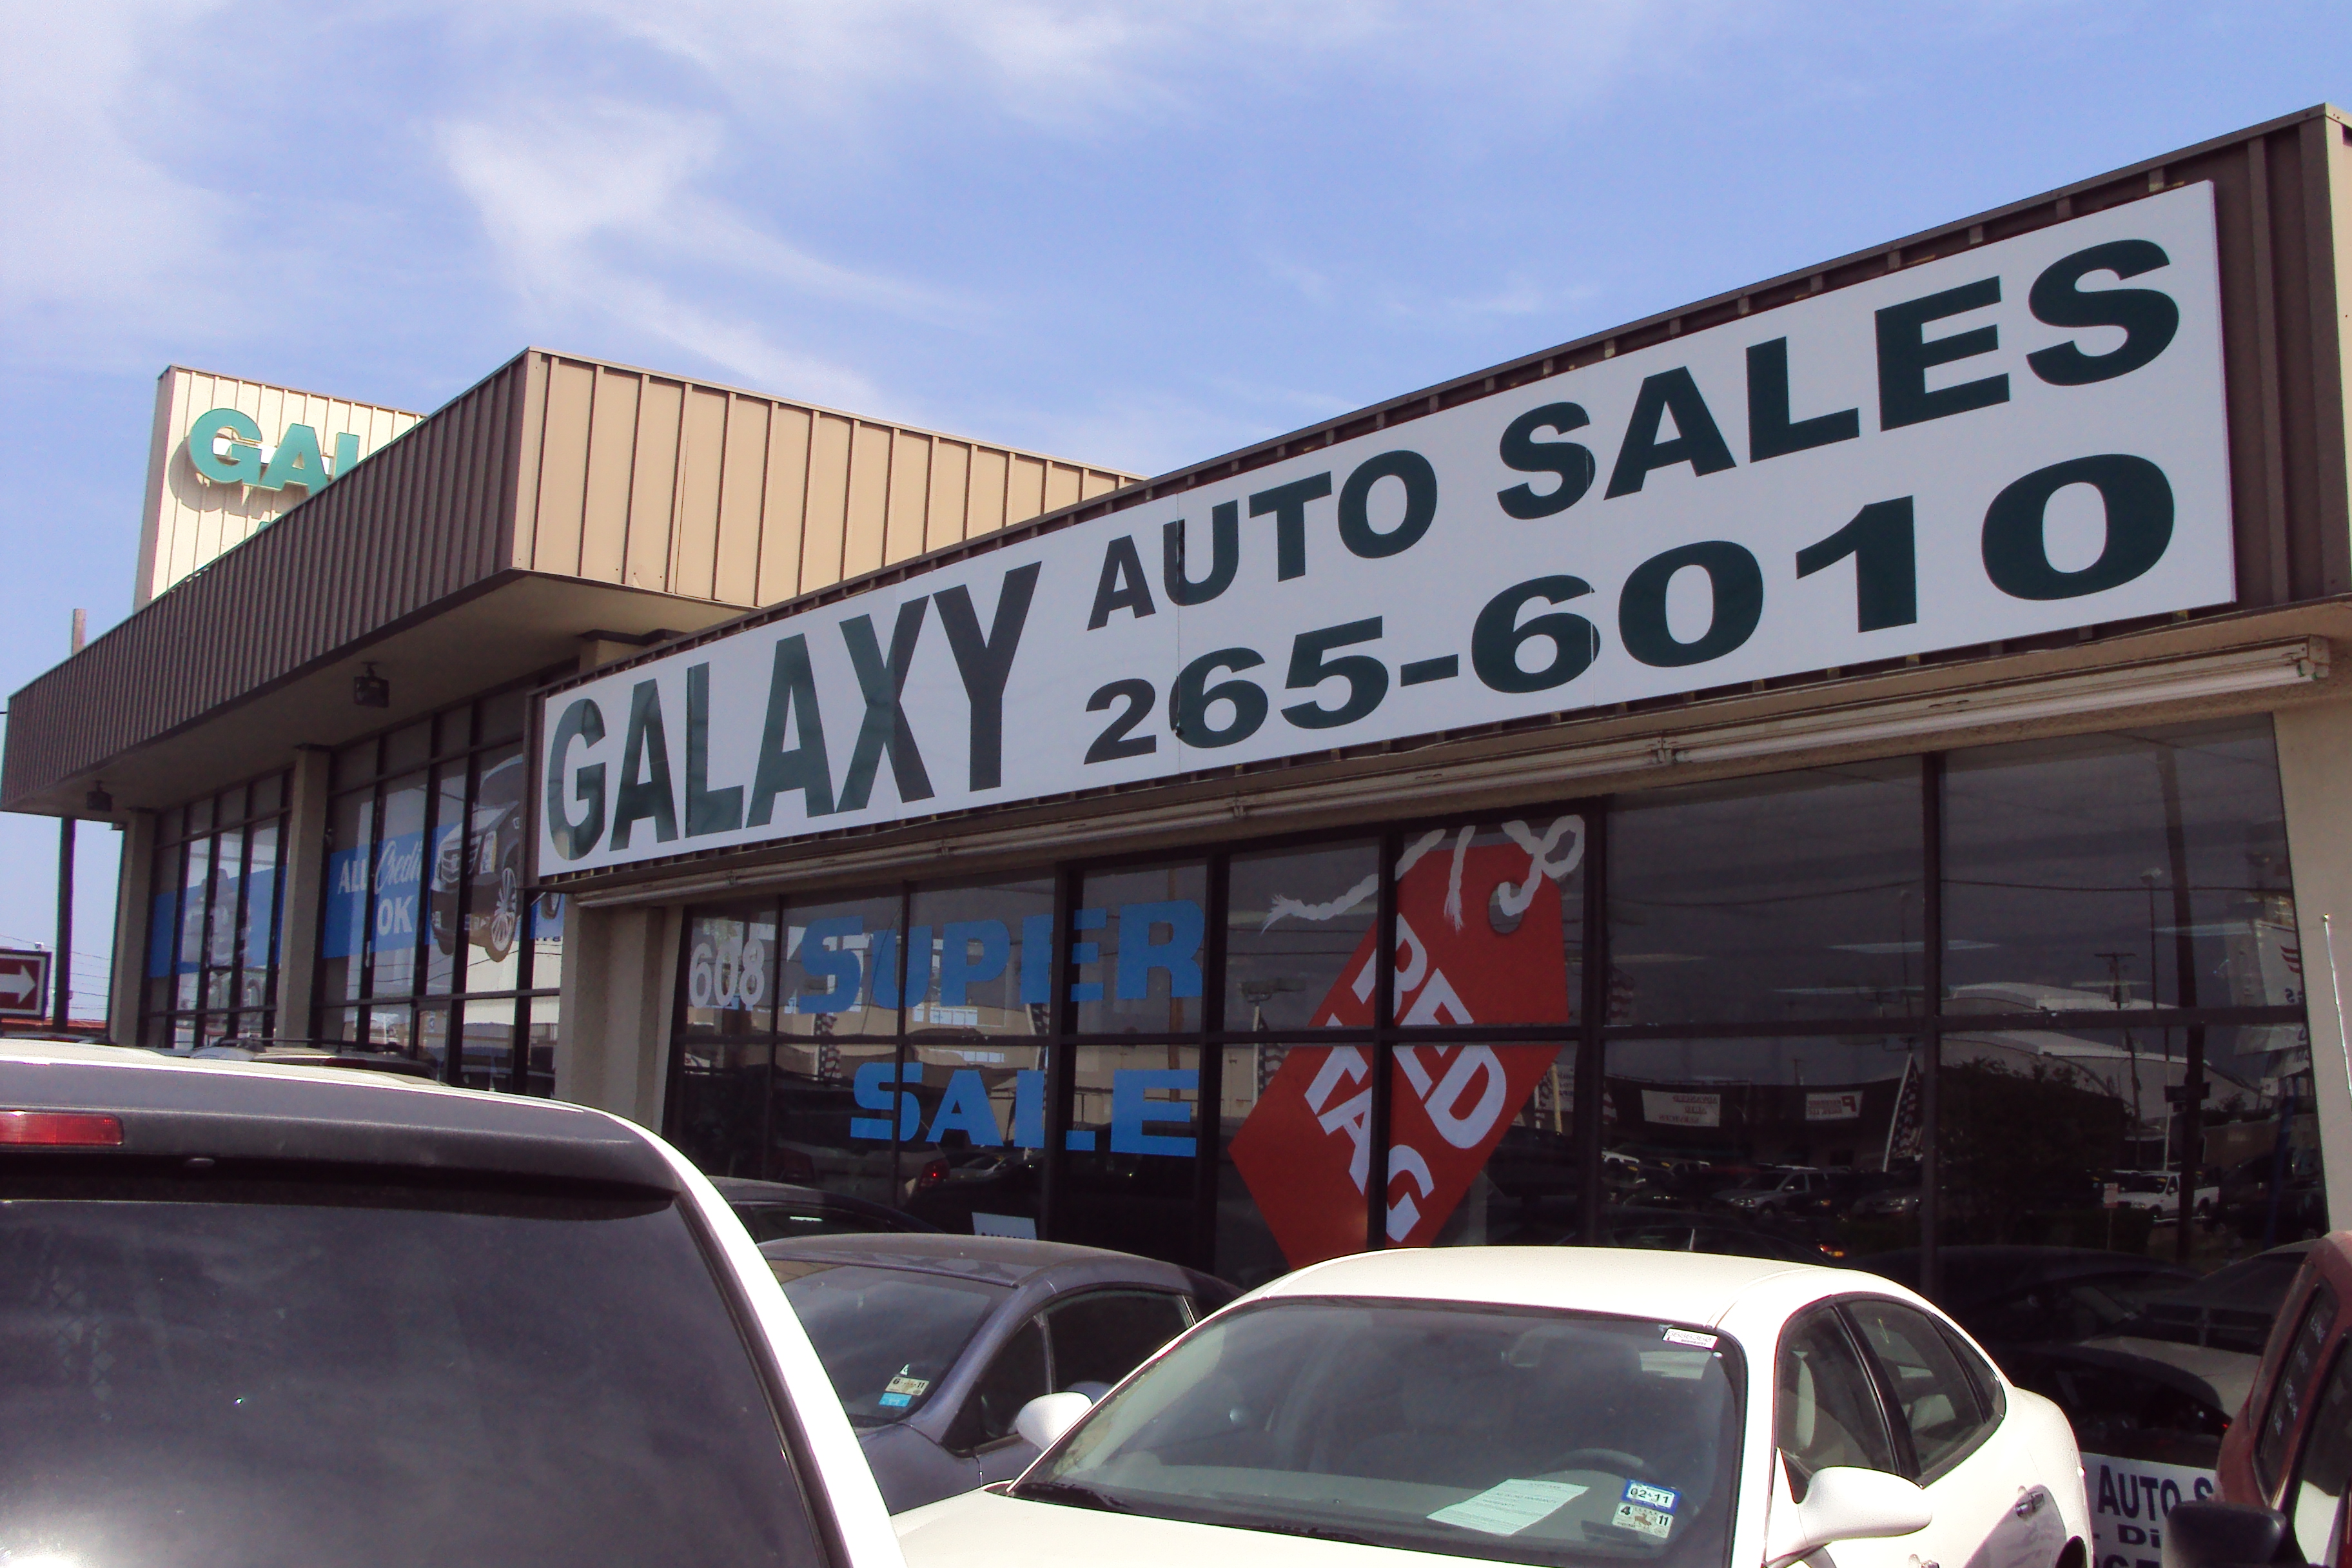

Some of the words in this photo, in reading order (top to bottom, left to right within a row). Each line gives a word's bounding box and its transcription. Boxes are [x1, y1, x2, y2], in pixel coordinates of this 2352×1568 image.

[547, 561, 1043, 861] GALAXY
[1086, 449, 1438, 631] AUTO
[1496, 239, 2180, 520] SALES
[1083, 453, 2175, 765] 265-6010
[377, 895, 415, 936] OK
[799, 899, 1205, 1014] SUPER
[689, 937, 765, 1009] 608
[1351, 912, 1507, 1150] RED
[850, 1061, 1199, 1157] SALE
[1304, 1012, 1435, 1242] TAG
[1620, 1505, 1631, 1516] 4
[1658, 1514, 1669, 1526] 11
[2097, 1464, 2182, 1522] AUTO
